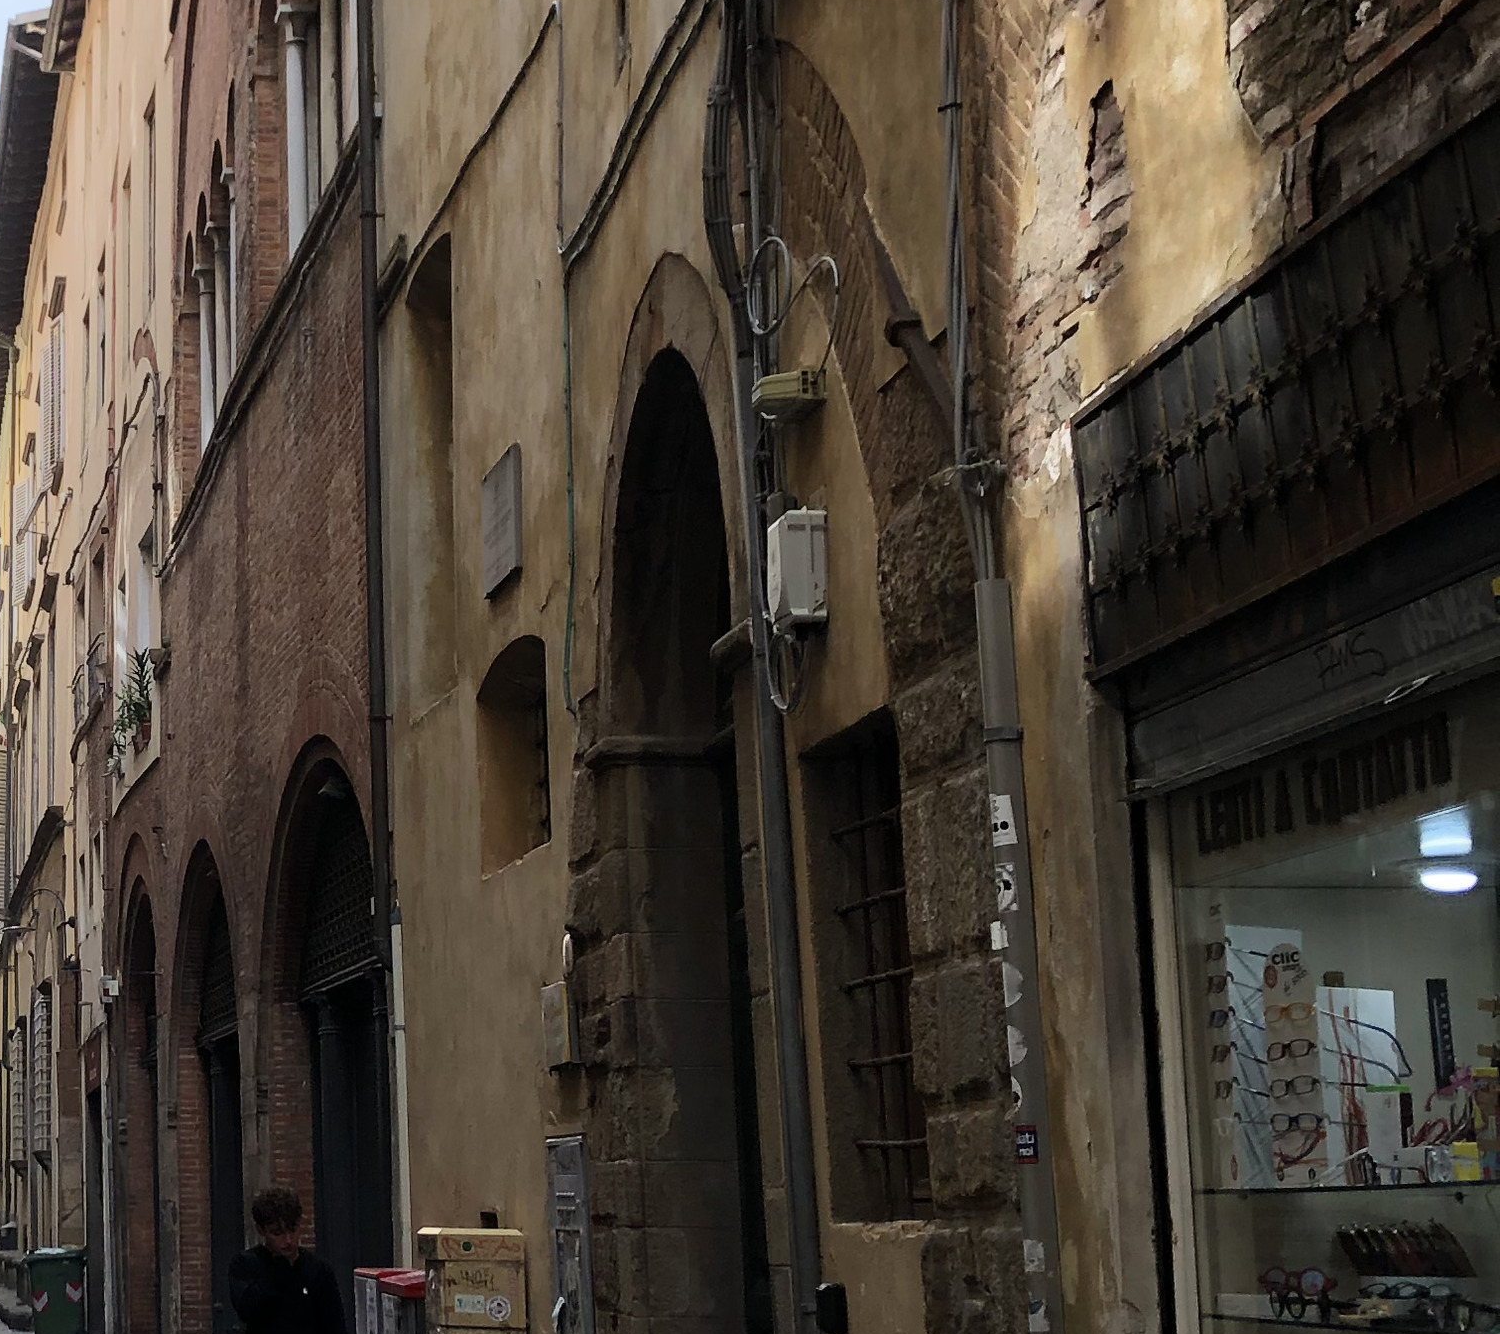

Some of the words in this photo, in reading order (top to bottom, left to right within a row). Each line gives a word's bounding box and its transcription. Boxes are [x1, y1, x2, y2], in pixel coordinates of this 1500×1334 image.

[1195, 775, 1266, 855] LENTI
[1274, 769, 1294, 834] A
[1301, 711, 1453, 826] CONTATTO
